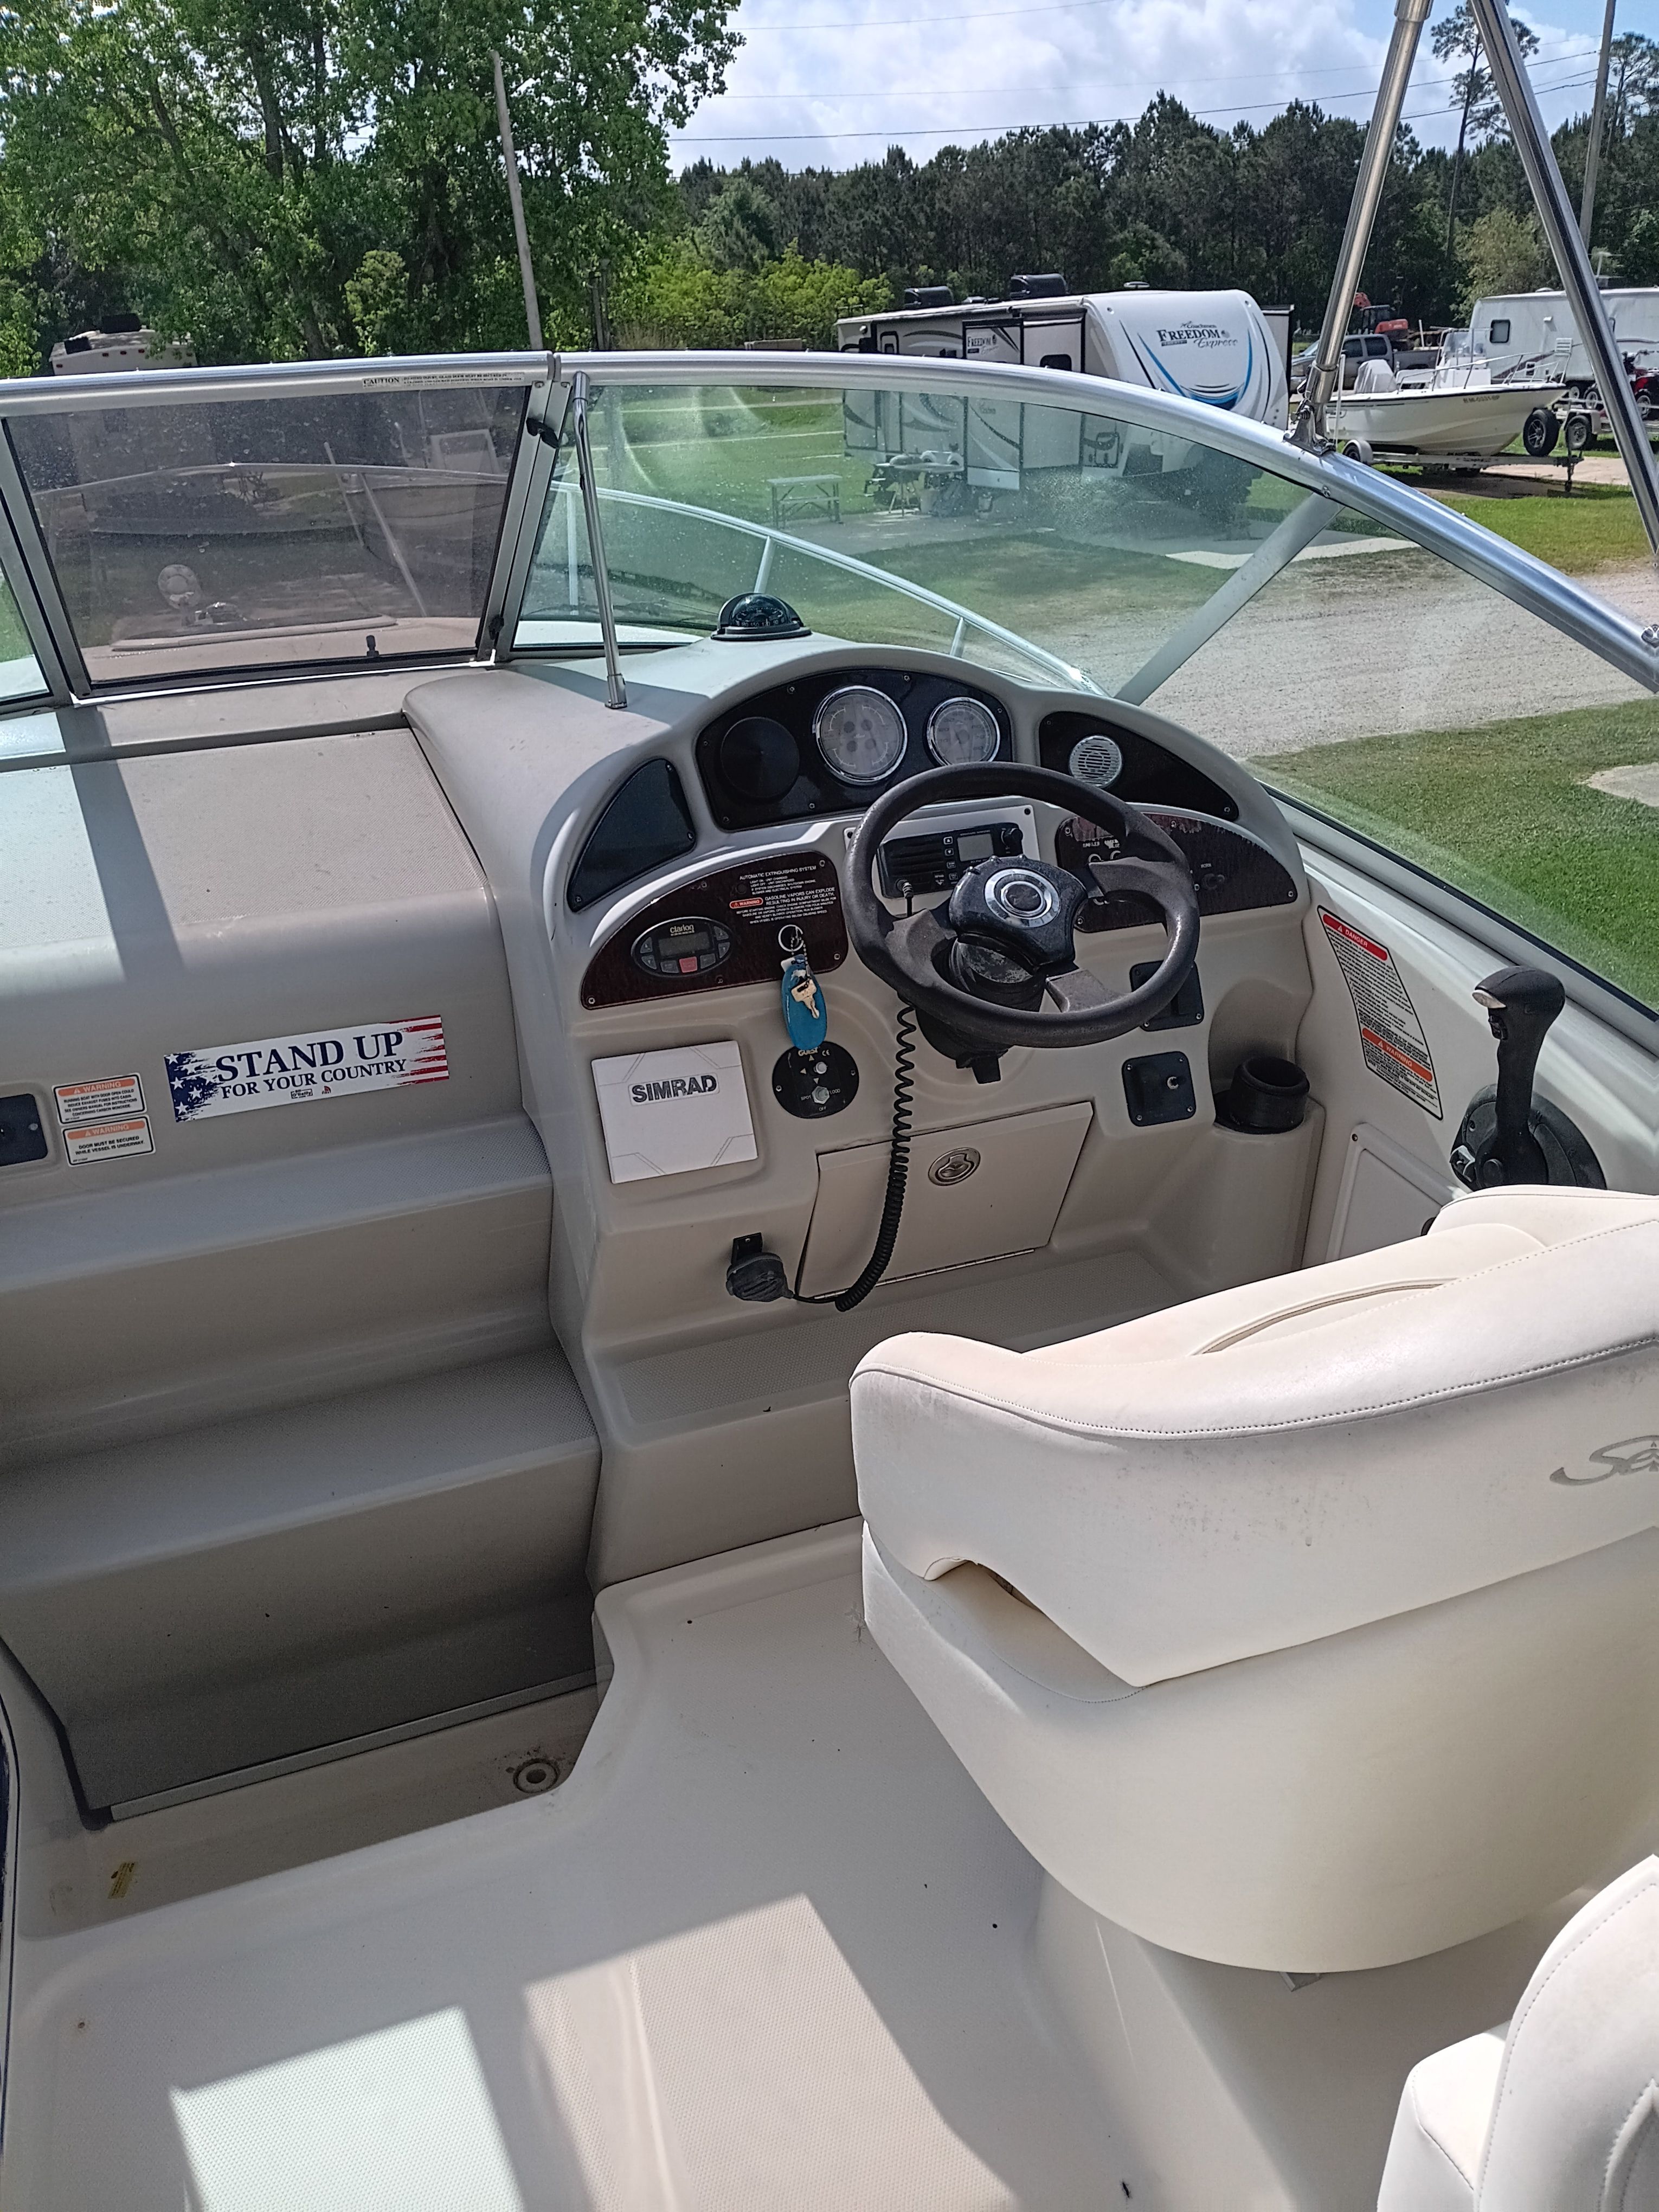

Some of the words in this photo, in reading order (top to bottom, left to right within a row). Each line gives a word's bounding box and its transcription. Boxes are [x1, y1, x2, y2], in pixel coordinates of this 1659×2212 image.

[1156, 329, 1220, 342] FREEDOM
[1193, 337, 1239, 349] Express
[363, 377, 400, 385] CAUTION
[740, 872, 765, 880] AUTOMATIC
[765, 868, 799, 877] EXTINGUISHING
[670, 924, 695, 934] clarion
[1345, 929, 1368, 948] DANGER
[216, 1039, 344, 1082] STAND
[353, 1031, 403, 1060] UP
[1385, 1044, 1413, 1067] WARNING
[221, 1081, 260, 1099] FOR
[263, 1072, 318, 1092] YOUR
[321, 1058, 407, 1083] COUNTRY
[83, 1081, 121, 1093] WARNING
[632, 1074, 717, 1103] SIMRAD
[112, 1097, 137, 1105] INSTRUCTIONS
[93, 1124, 130, 1135] WARNING
